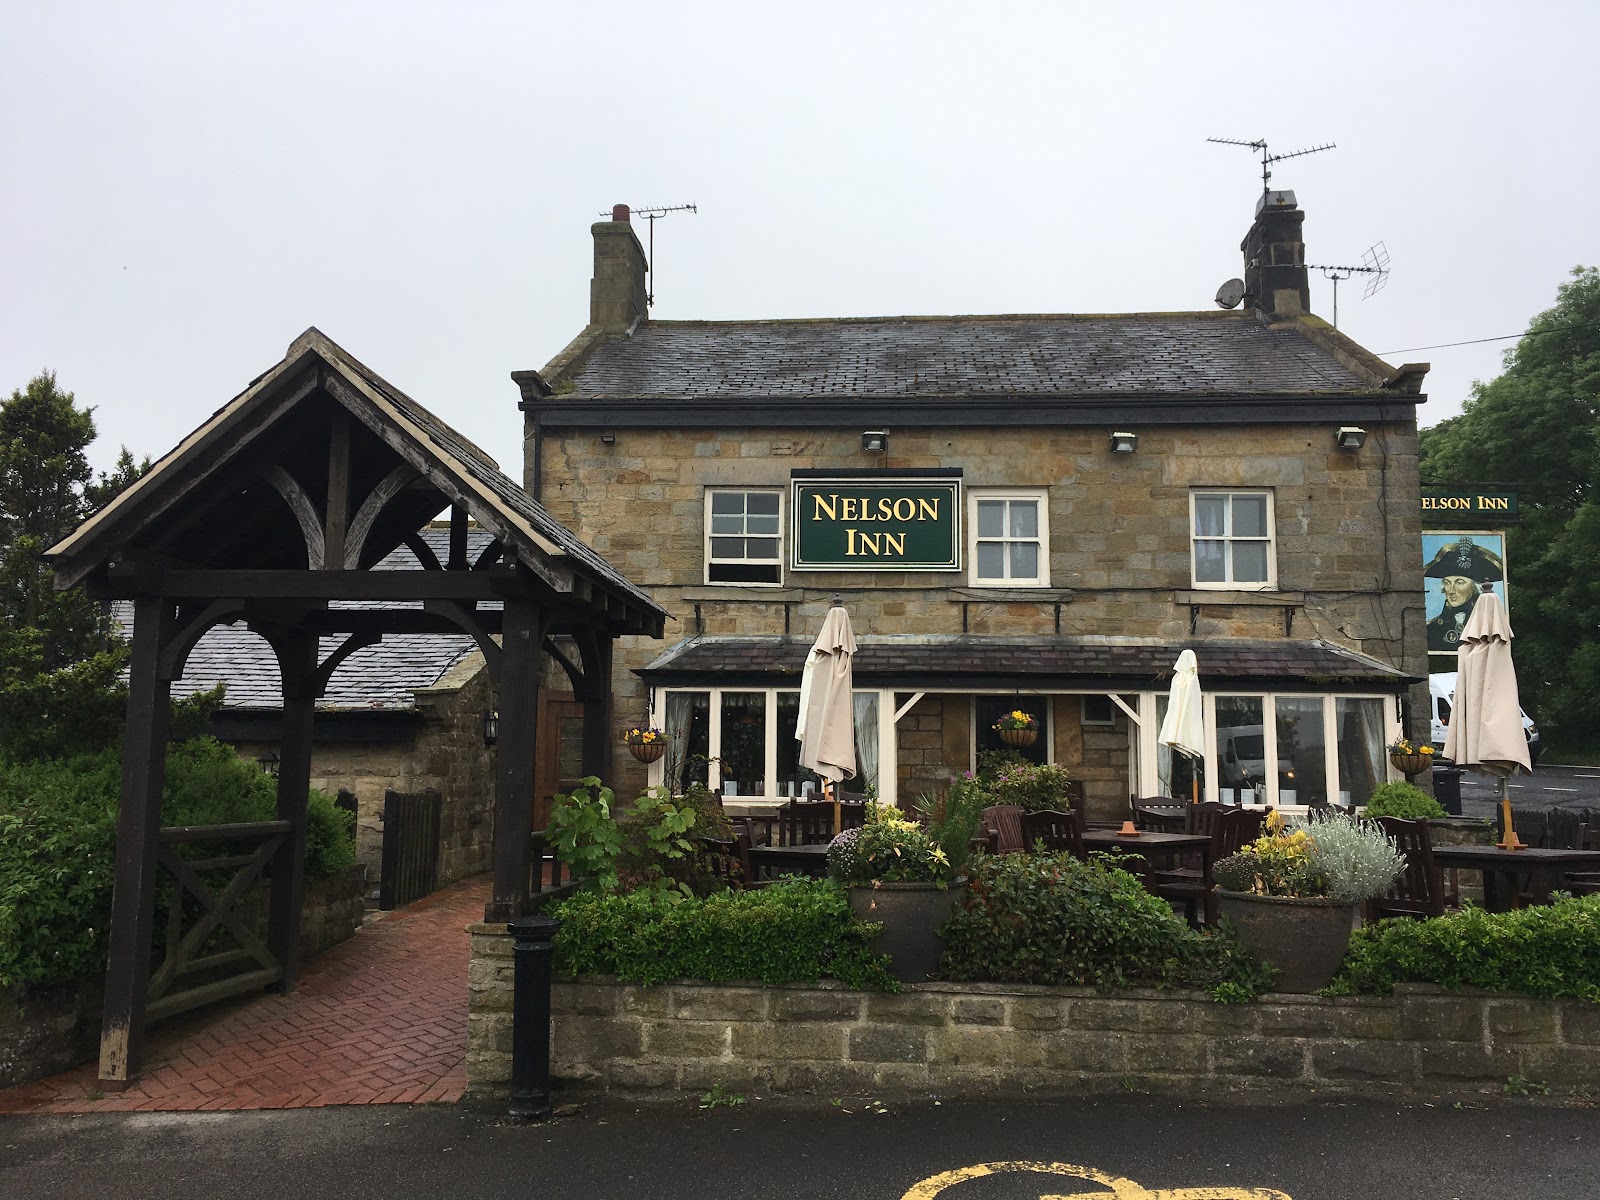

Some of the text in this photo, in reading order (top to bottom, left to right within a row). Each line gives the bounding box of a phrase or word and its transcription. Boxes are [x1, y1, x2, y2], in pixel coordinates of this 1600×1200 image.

[812, 494, 940, 521] NELSON
[1421, 495, 1509, 510] ELSON INN
[845, 529, 906, 556] INN
